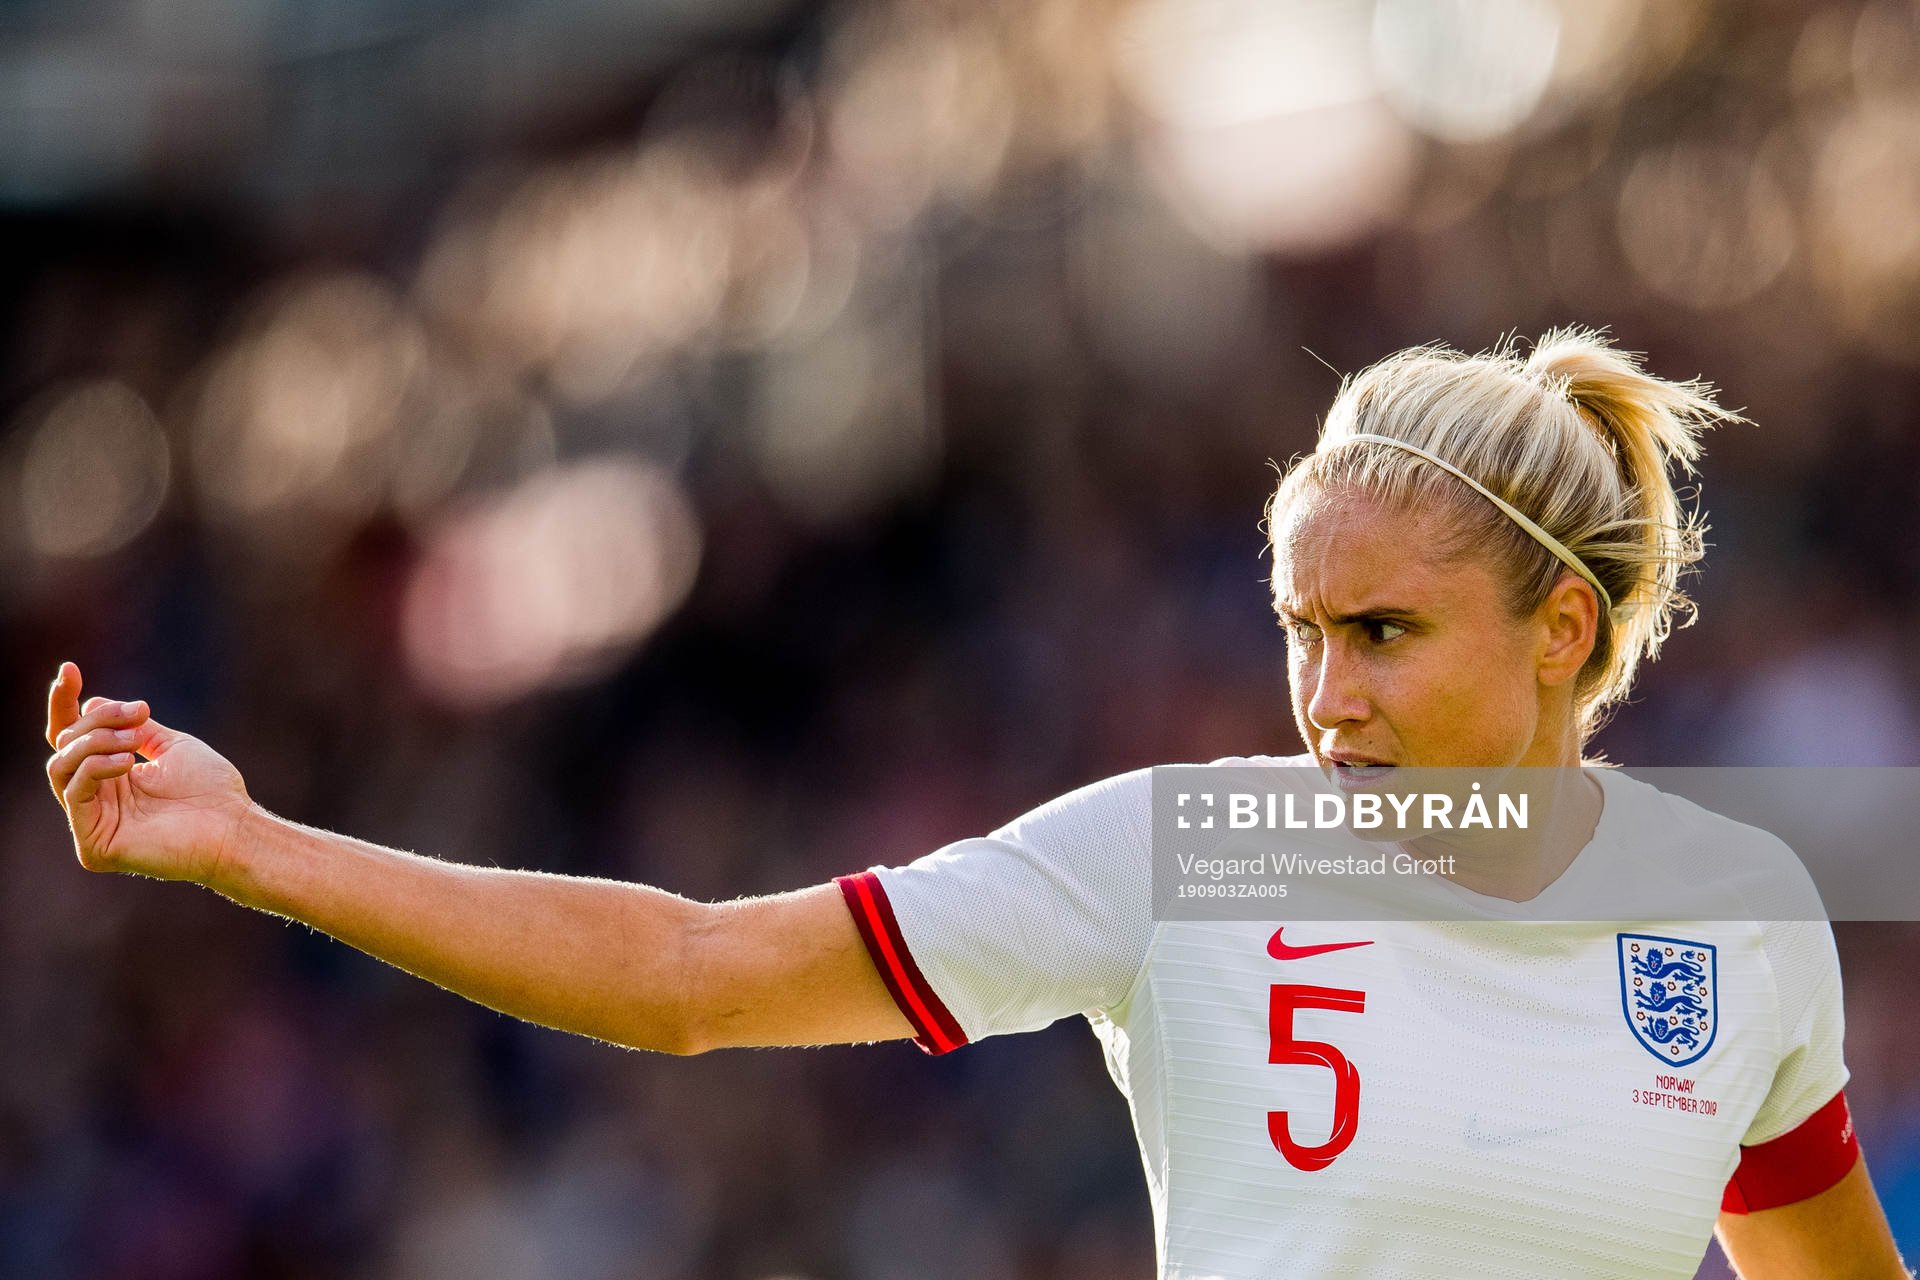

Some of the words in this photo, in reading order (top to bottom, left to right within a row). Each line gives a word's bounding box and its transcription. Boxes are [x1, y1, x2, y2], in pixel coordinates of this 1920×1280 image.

[1267, 984, 1366, 1172] 5
[1656, 1074, 1696, 1094] NORWAY
[1632, 1089, 1640, 1103] 3
[1642, 1090, 1698, 1113] SEPTEMBER
[1699, 1099, 1718, 1116] 2019
